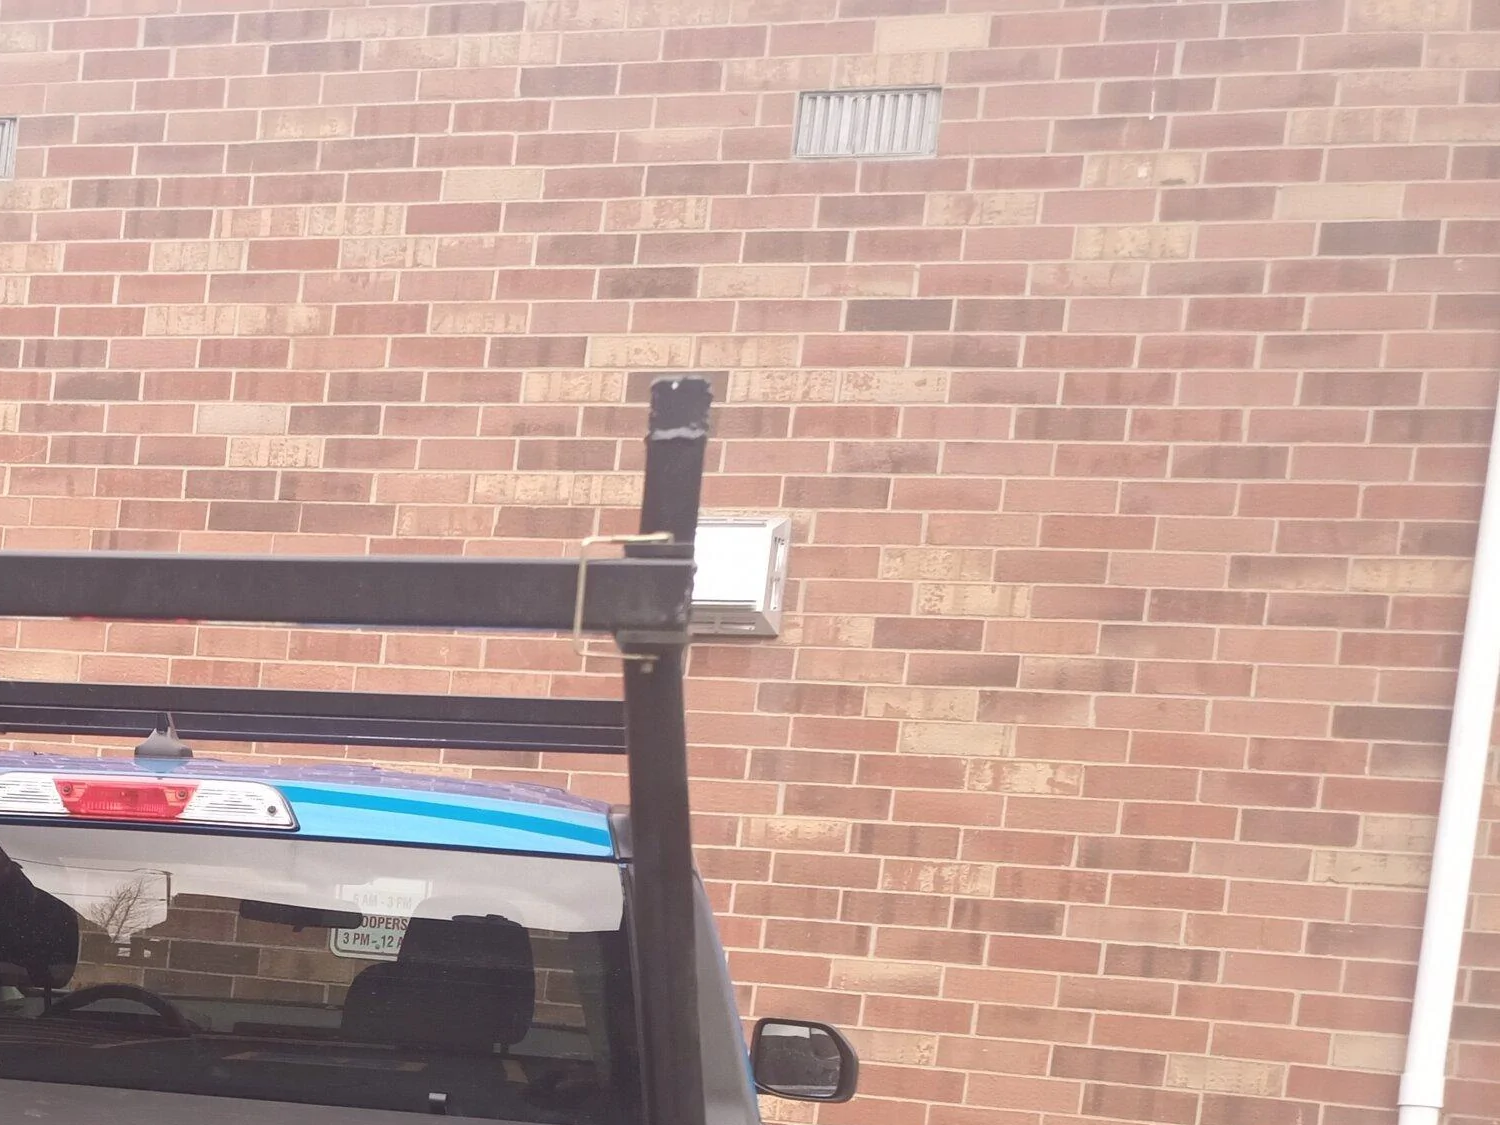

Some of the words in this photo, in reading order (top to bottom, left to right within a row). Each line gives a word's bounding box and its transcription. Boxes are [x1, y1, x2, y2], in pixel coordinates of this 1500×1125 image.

[361, 894, 378, 907] AM
[387, 896, 394, 908] 3
[396, 897, 412, 909] PM
[361, 915, 408, 931] OOPERS
[343, 932, 350, 944] 3
[353, 933, 370, 946] PM
[381, 935, 394, 948] 12
